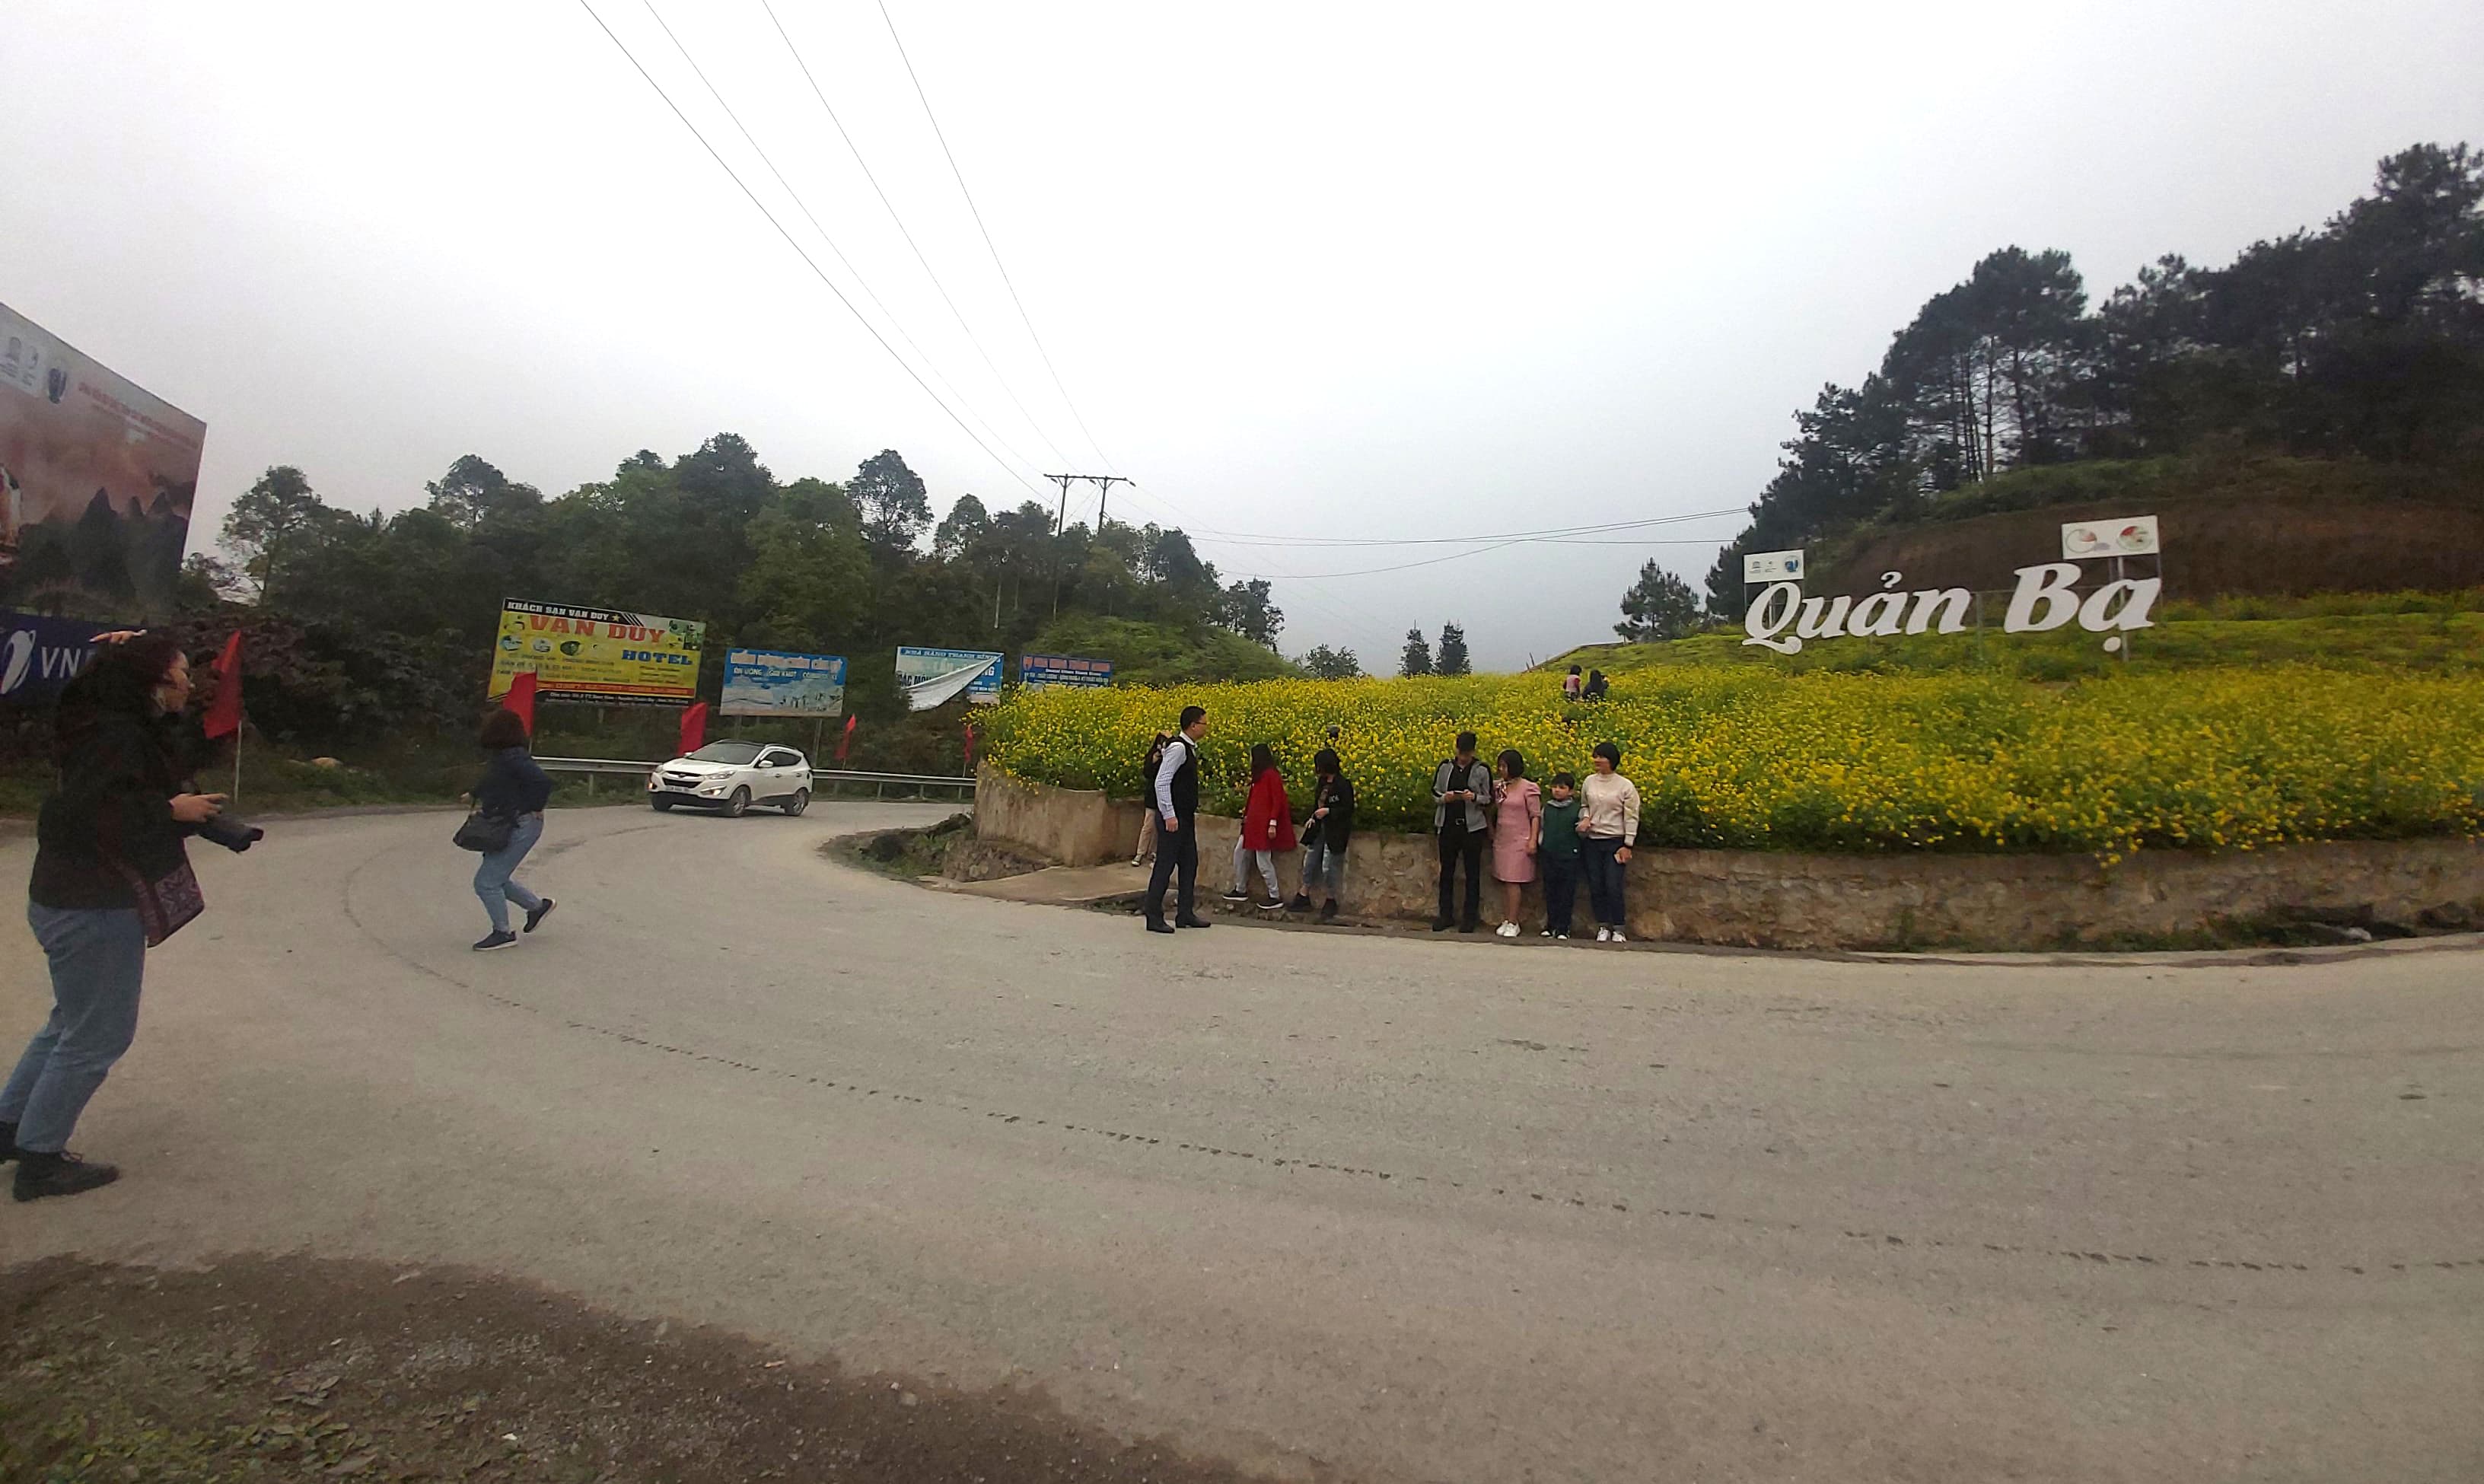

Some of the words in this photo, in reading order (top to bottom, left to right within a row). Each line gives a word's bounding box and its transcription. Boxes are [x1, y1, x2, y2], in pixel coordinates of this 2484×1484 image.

[590, 612, 610, 621] DUY
[1741, 571, 1973, 654] Quản
[2004, 562, 2161, 652] Bạ
[608, 624, 665, 643] DUY
[621, 649, 693, 665] HOTEL
